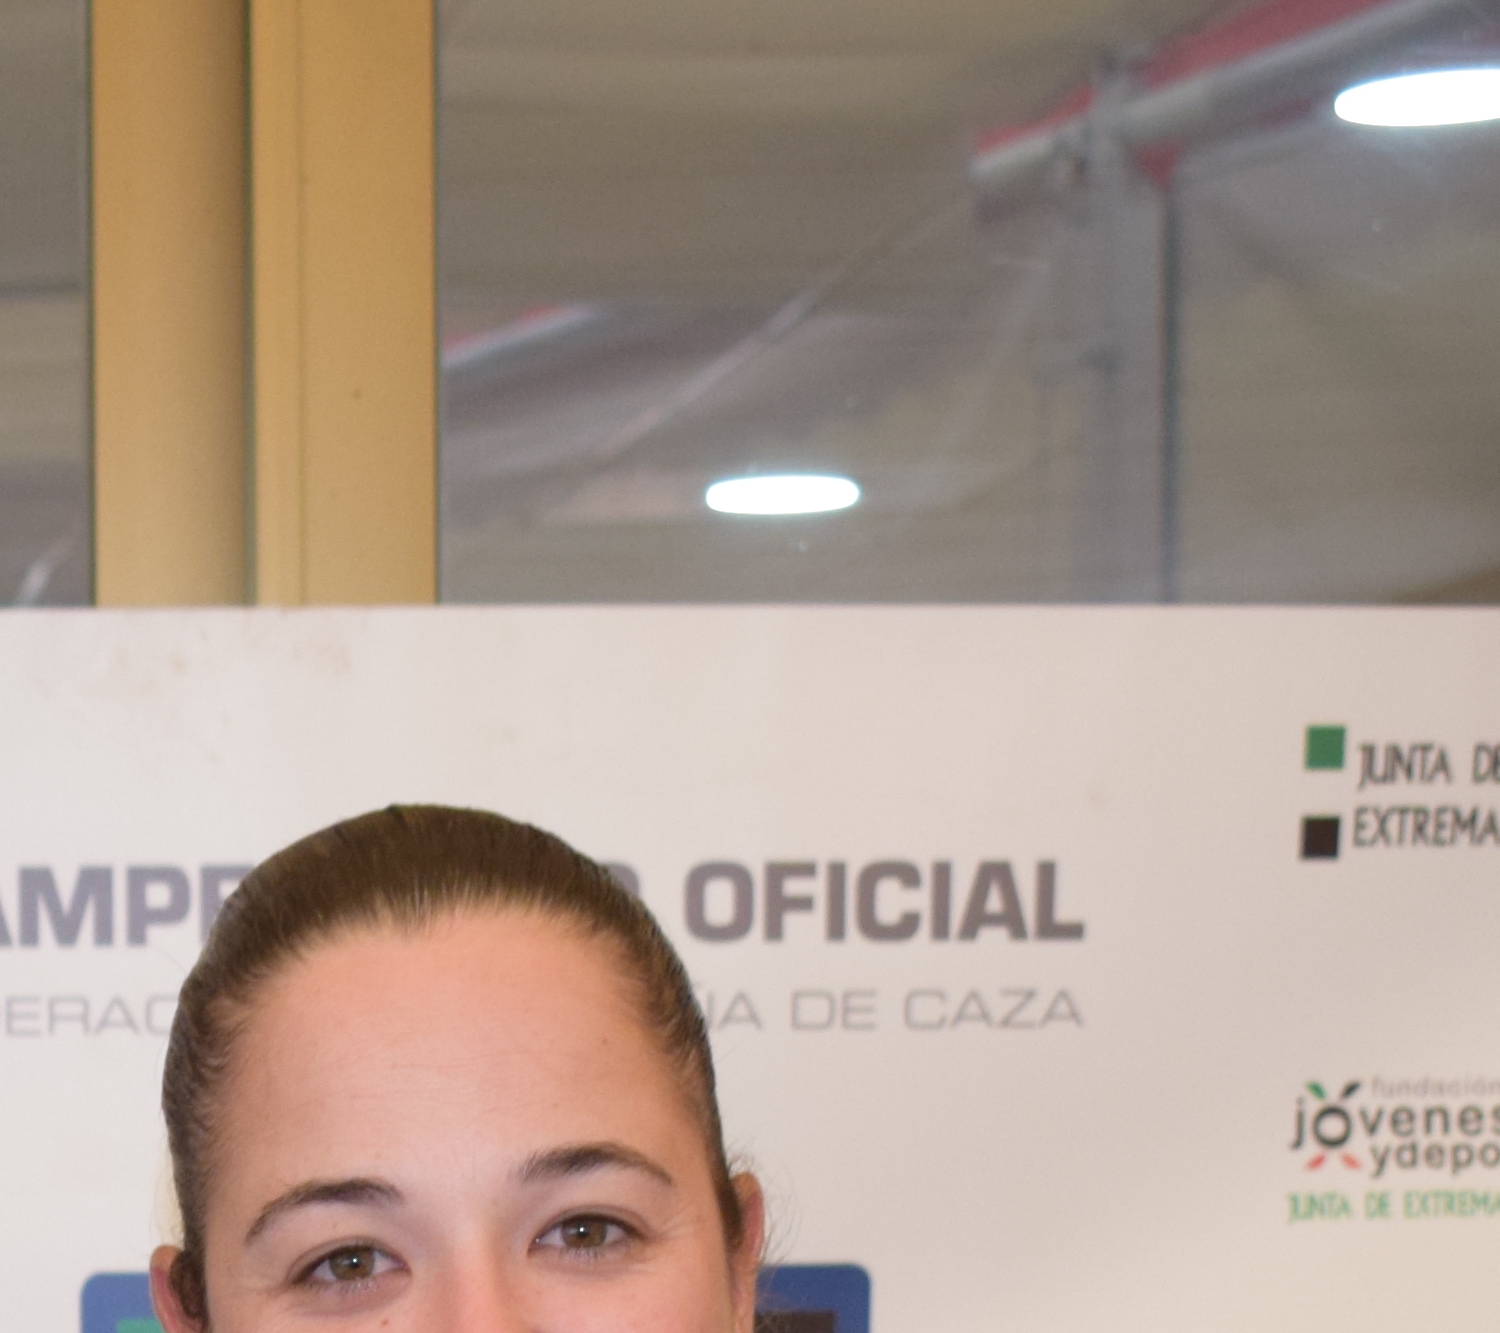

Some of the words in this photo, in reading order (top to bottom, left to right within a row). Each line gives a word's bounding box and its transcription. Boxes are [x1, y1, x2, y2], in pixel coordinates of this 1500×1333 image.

[1356, 742, 1452, 790] JUNTA
[683, 859, 1086, 944] OFICIAL
[790, 988, 877, 1031] DE
[904, 986, 1086, 1031] CAZA
[1288, 1192, 1353, 1223] JUNTA
[1364, 1190, 1390, 1219] DE
